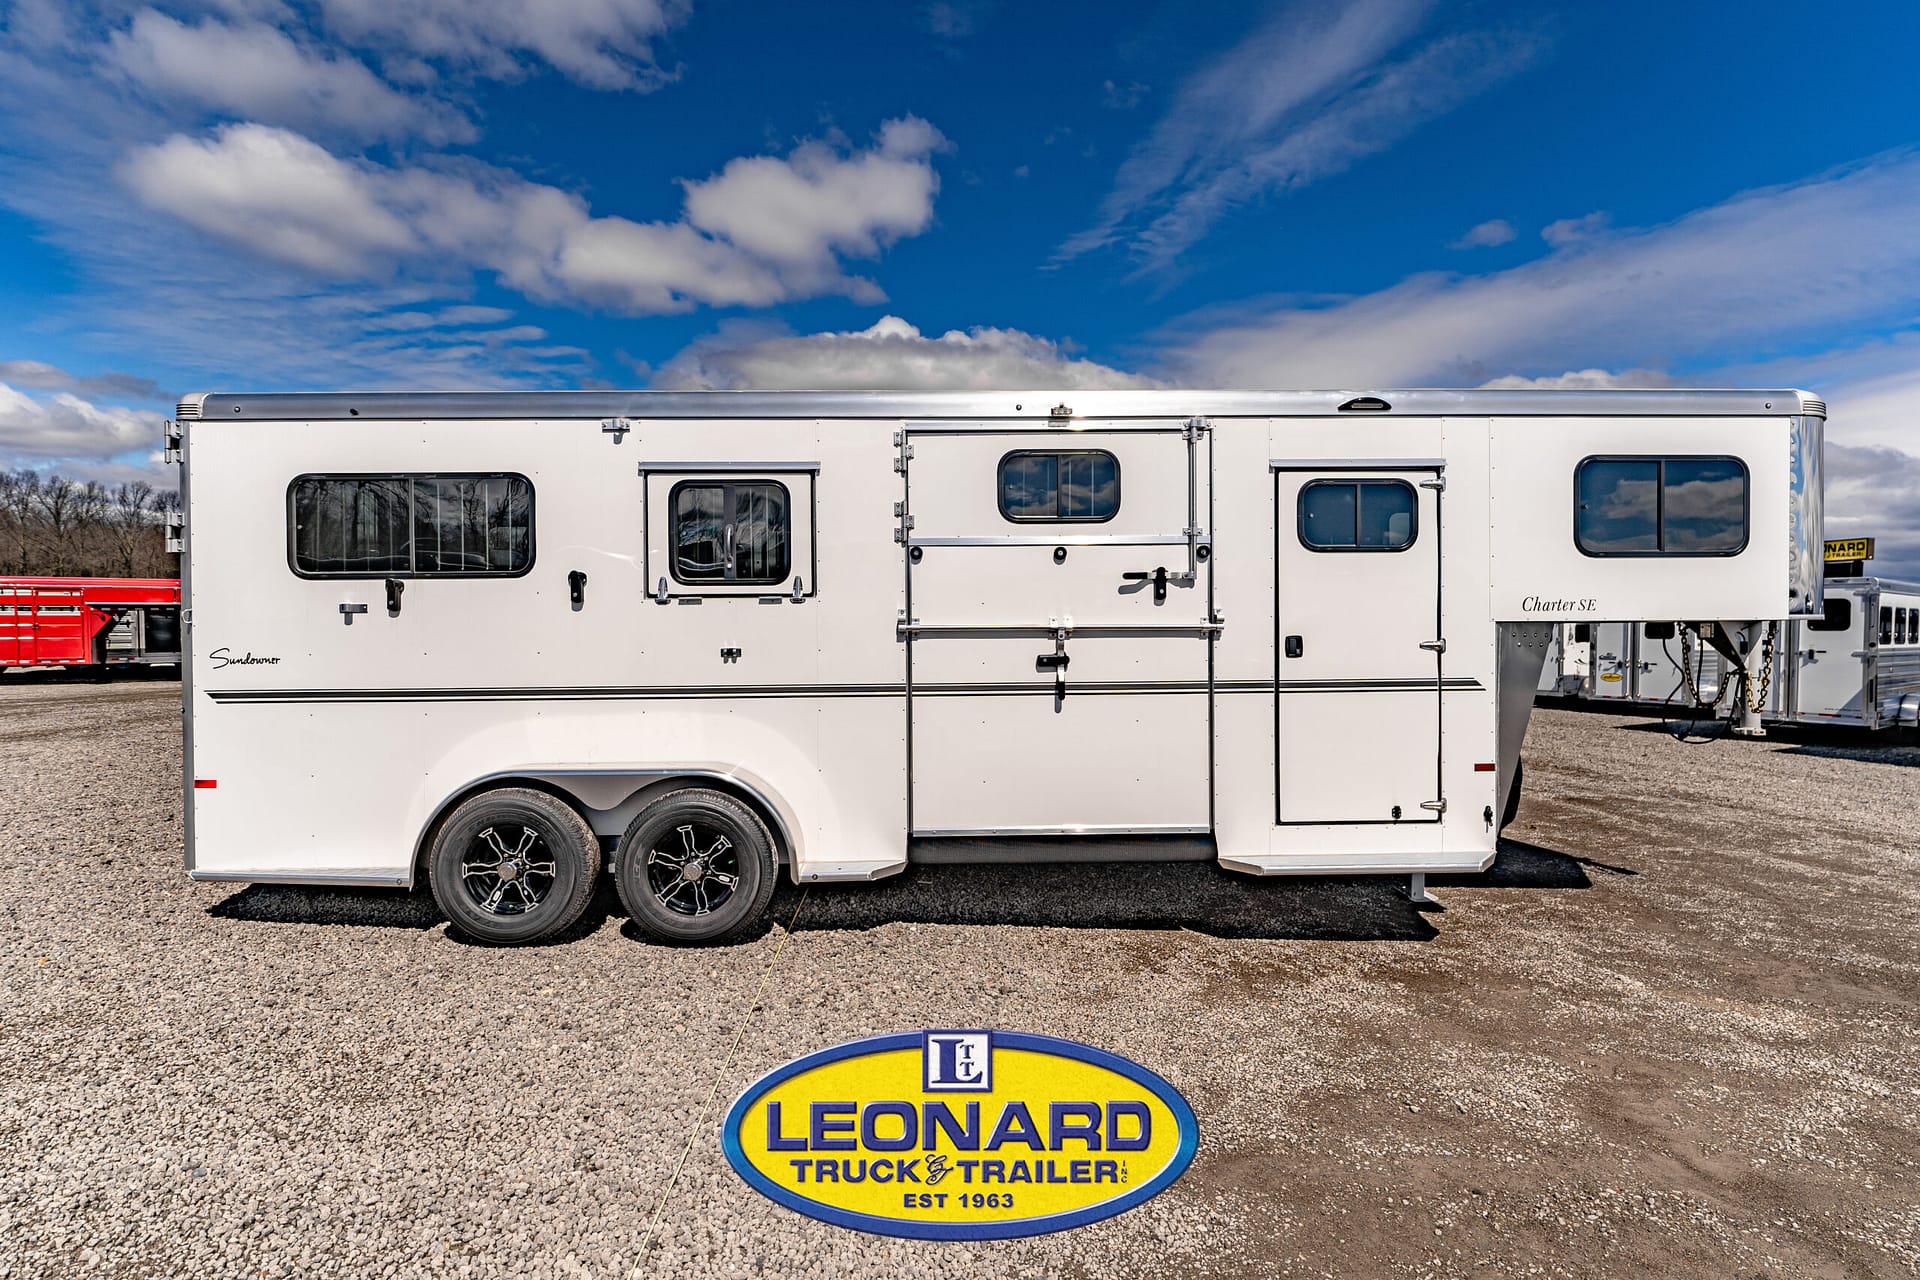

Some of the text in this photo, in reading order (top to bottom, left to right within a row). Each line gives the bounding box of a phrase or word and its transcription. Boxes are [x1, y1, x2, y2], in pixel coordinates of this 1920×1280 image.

[1522, 596, 1597, 612] Charter SE
[209, 647, 281, 670] Sundowner
